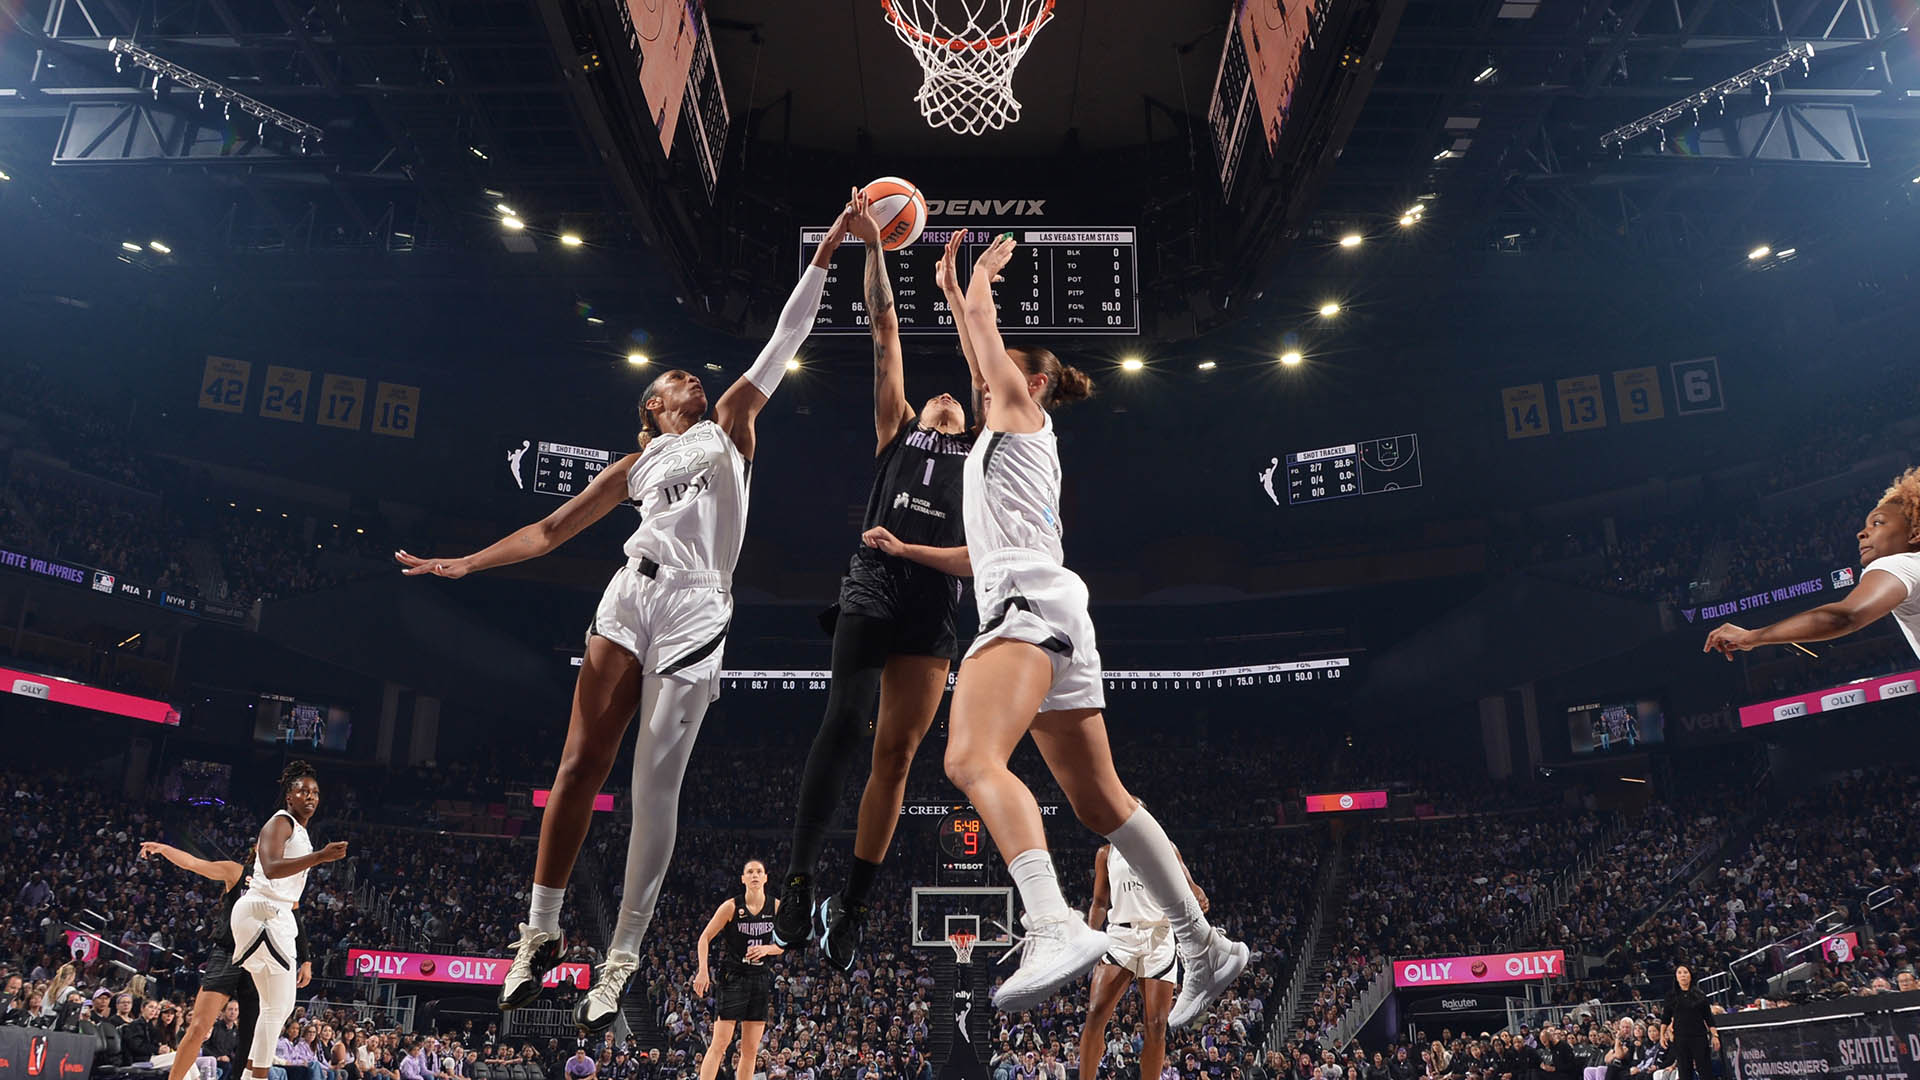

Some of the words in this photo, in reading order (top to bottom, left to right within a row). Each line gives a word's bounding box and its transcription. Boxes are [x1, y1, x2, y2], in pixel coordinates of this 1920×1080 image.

[926, 200, 1047, 216] DENVIX
[922, 231, 975, 243] PRESEED
[977, 231, 990, 243] BY
[1039, 233, 1051, 242] LAS
[1054, 233, 1077, 242] VEGAS
[1077, 233, 1097, 242] TEAM
[1097, 233, 1119, 242] STATS
[1032, 248, 1038, 257] 2
[1113, 248, 1119, 257] 0
[1034, 261, 1038, 270] 1
[1113, 262, 1119, 270] 0
[1033, 275, 1039, 284] 3
[1113, 275, 1120, 284] 0
[1033, 288, 1039, 297] 0
[1114, 288, 1120, 297] 6
[851, 302, 865, 311] 66.
[1020, 302, 1039, 311] 75.0
[1101, 302, 1121, 311] 50.0
[856, 316, 869, 325] 0.0
[938, 315, 952, 325] 0.0
[1025, 315, 1039, 325] 0.0
[1107, 315, 1121, 325] 0.0
[1683, 369, 1711, 402] 6
[205, 377, 244, 407] 42
[265, 385, 303, 416] 24
[1631, 387, 1649, 415] 9
[327, 394, 356, 423] 17
[1568, 395, 1598, 425] 13
[379, 402, 410, 430] 16
[1512, 403, 1542, 432] 14
[555, 445, 572, 454] SHOT
[573, 447, 600, 458] TRACKER
[1303, 451, 1319, 459] SHOT
[1320, 447, 1347, 456] TRACKER
[560, 458, 573, 468] 3/6
[662, 447, 713, 479] 22
[1310, 463, 1322, 472] 2/7
[559, 471, 572, 480] 0/2
[922, 458, 936, 486] 1
[1311, 475, 1324, 485] 0/4
[557, 483, 571, 492] 0/0
[664, 474, 715, 505] IPSY
[1311, 487, 1325, 497] 0/0
[0, 550, 28, 569] TATE
[30, 558, 84, 584] VALKYRIES
[92, 583, 113, 594] SCORES
[1833, 579, 1854, 590] SCORES
[121, 584, 140, 596] MIA
[147, 589, 152, 599] 1
[166, 595, 185, 607] NYM
[189, 600, 196, 610] 5
[1701, 601, 1738, 620] GOLDEN
[1739, 592, 1770, 612] STATE
[1771, 578, 1823, 602] VALKYRIES
[1110, 681, 1115, 690] 3
[1131, 681, 1136, 689] 0
[1153, 681, 1158, 689] 0
[1174, 681, 1180, 689] 0
[1195, 680, 1201, 689] 0
[1217, 679, 1222, 688] 6
[1237, 676, 1254, 686] 75.0
[1268, 674, 1281, 683] 0.0
[1295, 672, 1312, 681] 50.0
[1327, 669, 1340, 678] 0.0
[20, 684, 42, 695] OLLY
[731, 681, 736, 689] 4
[752, 681, 768, 689] 66.7
[782, 681, 795, 689] 0.0
[809, 681, 826, 690] 28.6
[1887, 684, 1909, 695] OLLY
[1831, 694, 1856, 705] OLLY
[1780, 706, 1800, 717] OLLY
[909, 806, 949, 815] CREEK
[954, 820, 980, 832] 6:48
[964, 832, 977, 854] 9
[1122, 880, 1145, 893] IPS
[737, 922, 774, 936] VALKYRIES
[356, 954, 408, 975] OLLY
[447, 960, 497, 980] OLLY
[1505, 955, 1556, 976] OLLY
[1404, 962, 1453, 982] OLLY
[955, 991, 972, 1000] ally
[1442, 998, 1477, 1010] Rakuten
[1742, 1049, 1767, 1060] WNBA
[1839, 1036, 1898, 1066] SEATTLE
